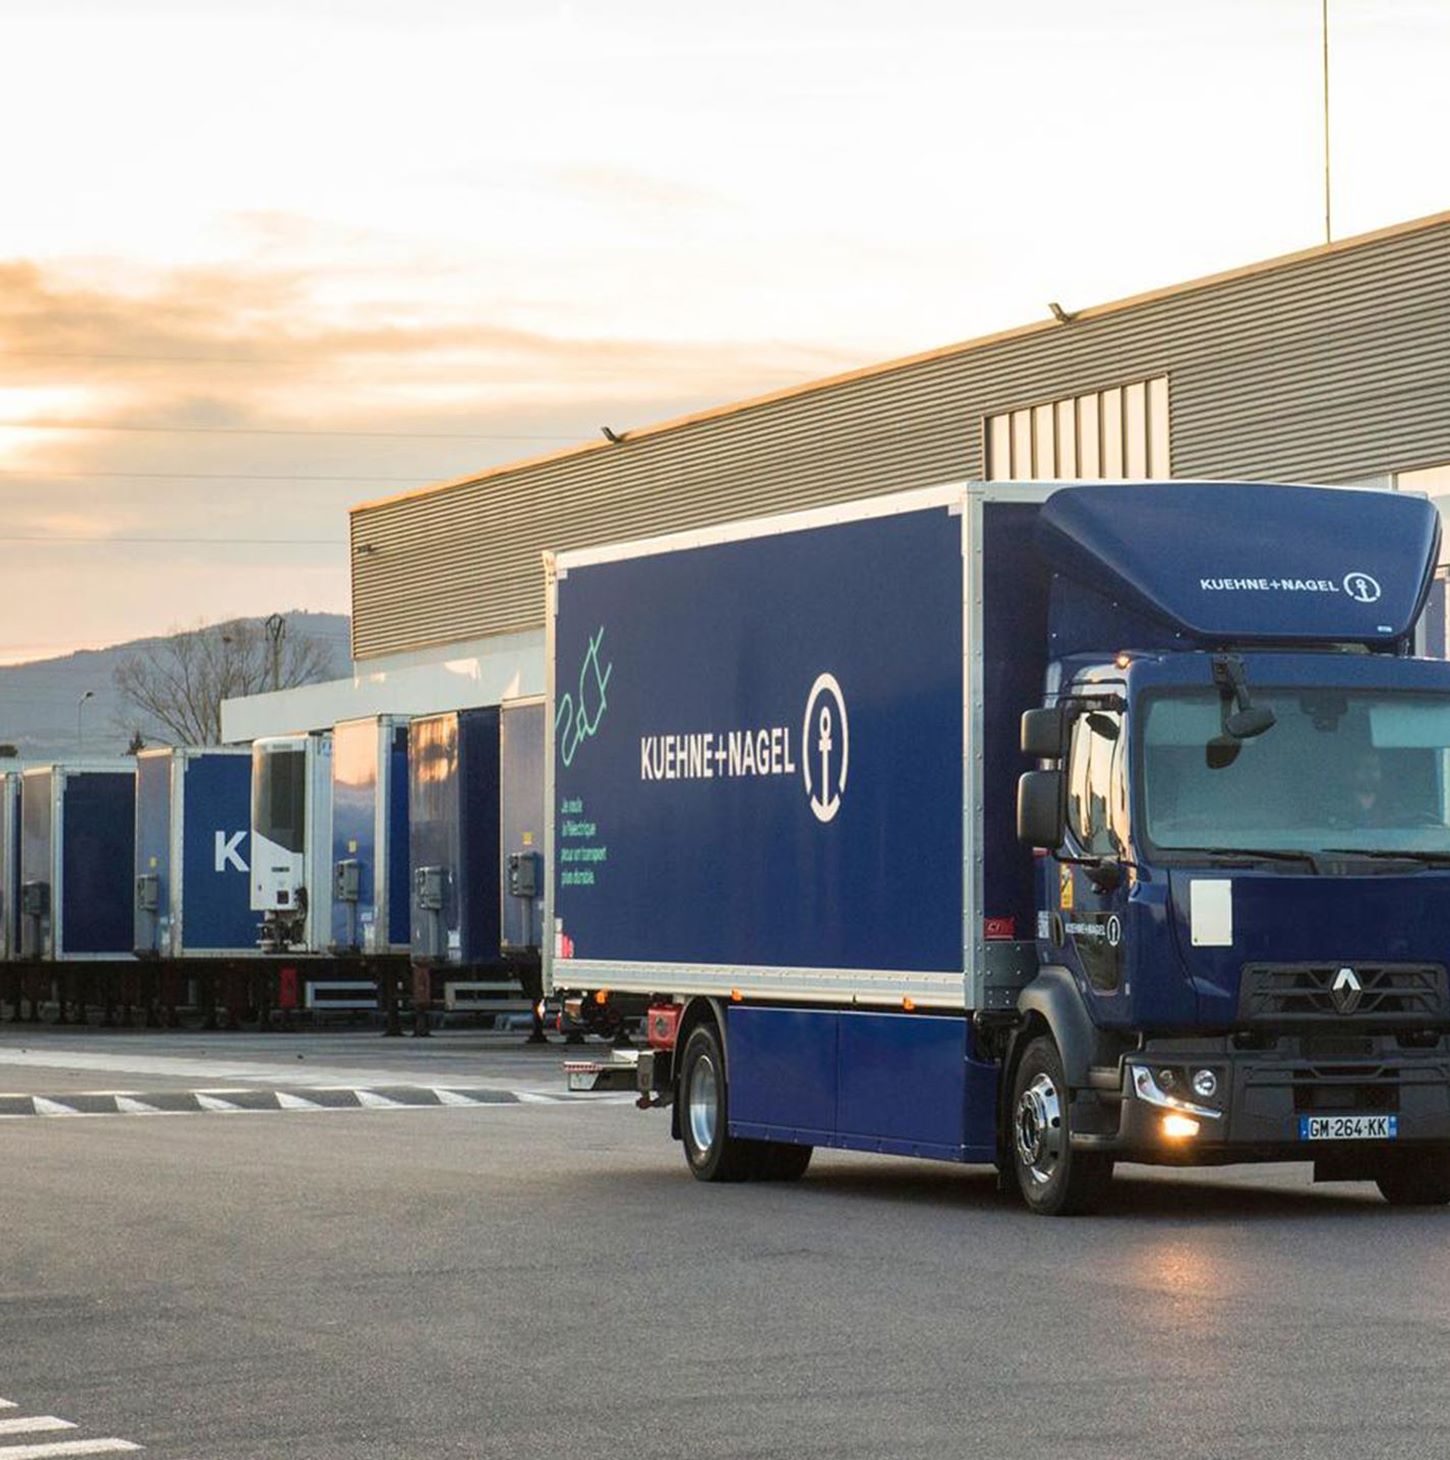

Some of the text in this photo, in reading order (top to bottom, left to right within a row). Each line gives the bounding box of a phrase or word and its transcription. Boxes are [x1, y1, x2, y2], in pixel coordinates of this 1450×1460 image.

[1200, 577, 1340, 592] KUEHNE+NAGEL
[640, 727, 795, 780] KUEHNE+NAGEL
[1310, 1118, 1387, 1137] GM-264-KK
